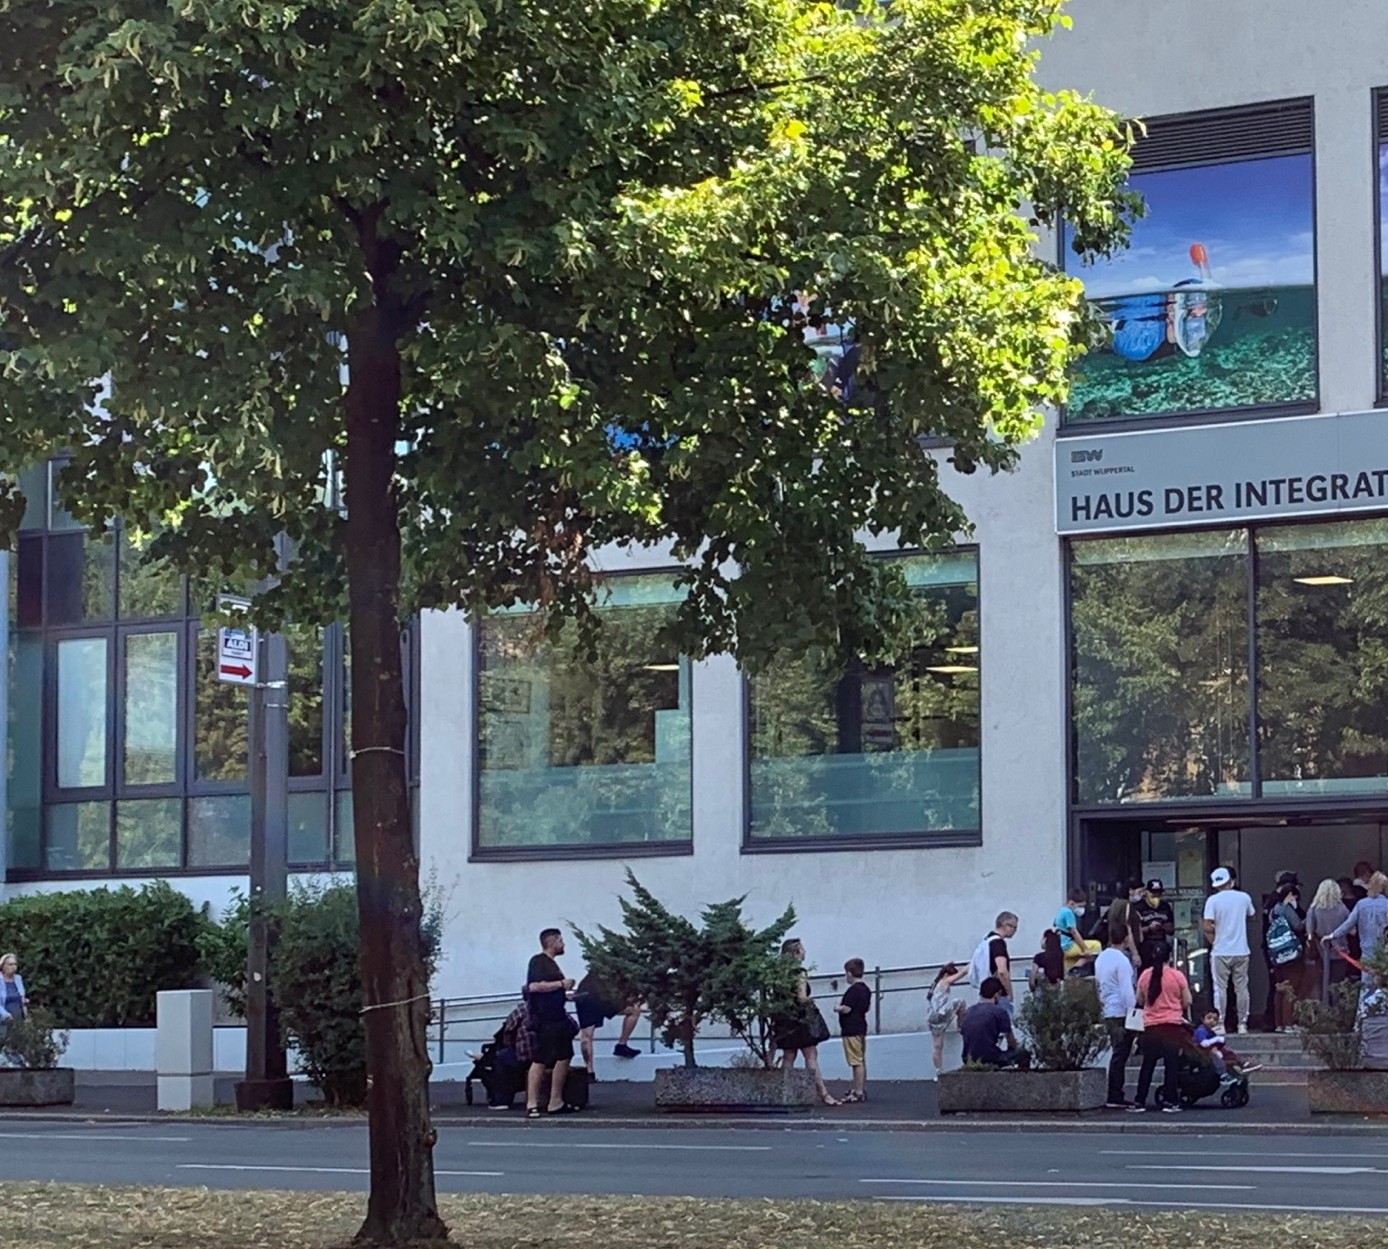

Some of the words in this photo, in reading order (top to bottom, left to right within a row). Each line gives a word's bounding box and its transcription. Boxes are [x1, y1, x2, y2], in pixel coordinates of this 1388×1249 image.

[1071, 469, 1092, 478] STADT
[1093, 466, 1135, 476] WUPPERTAL
[1071, 490, 1154, 521] HAUS
[1164, 484, 1224, 514] DER
[226, 639, 249, 651] ALDI
